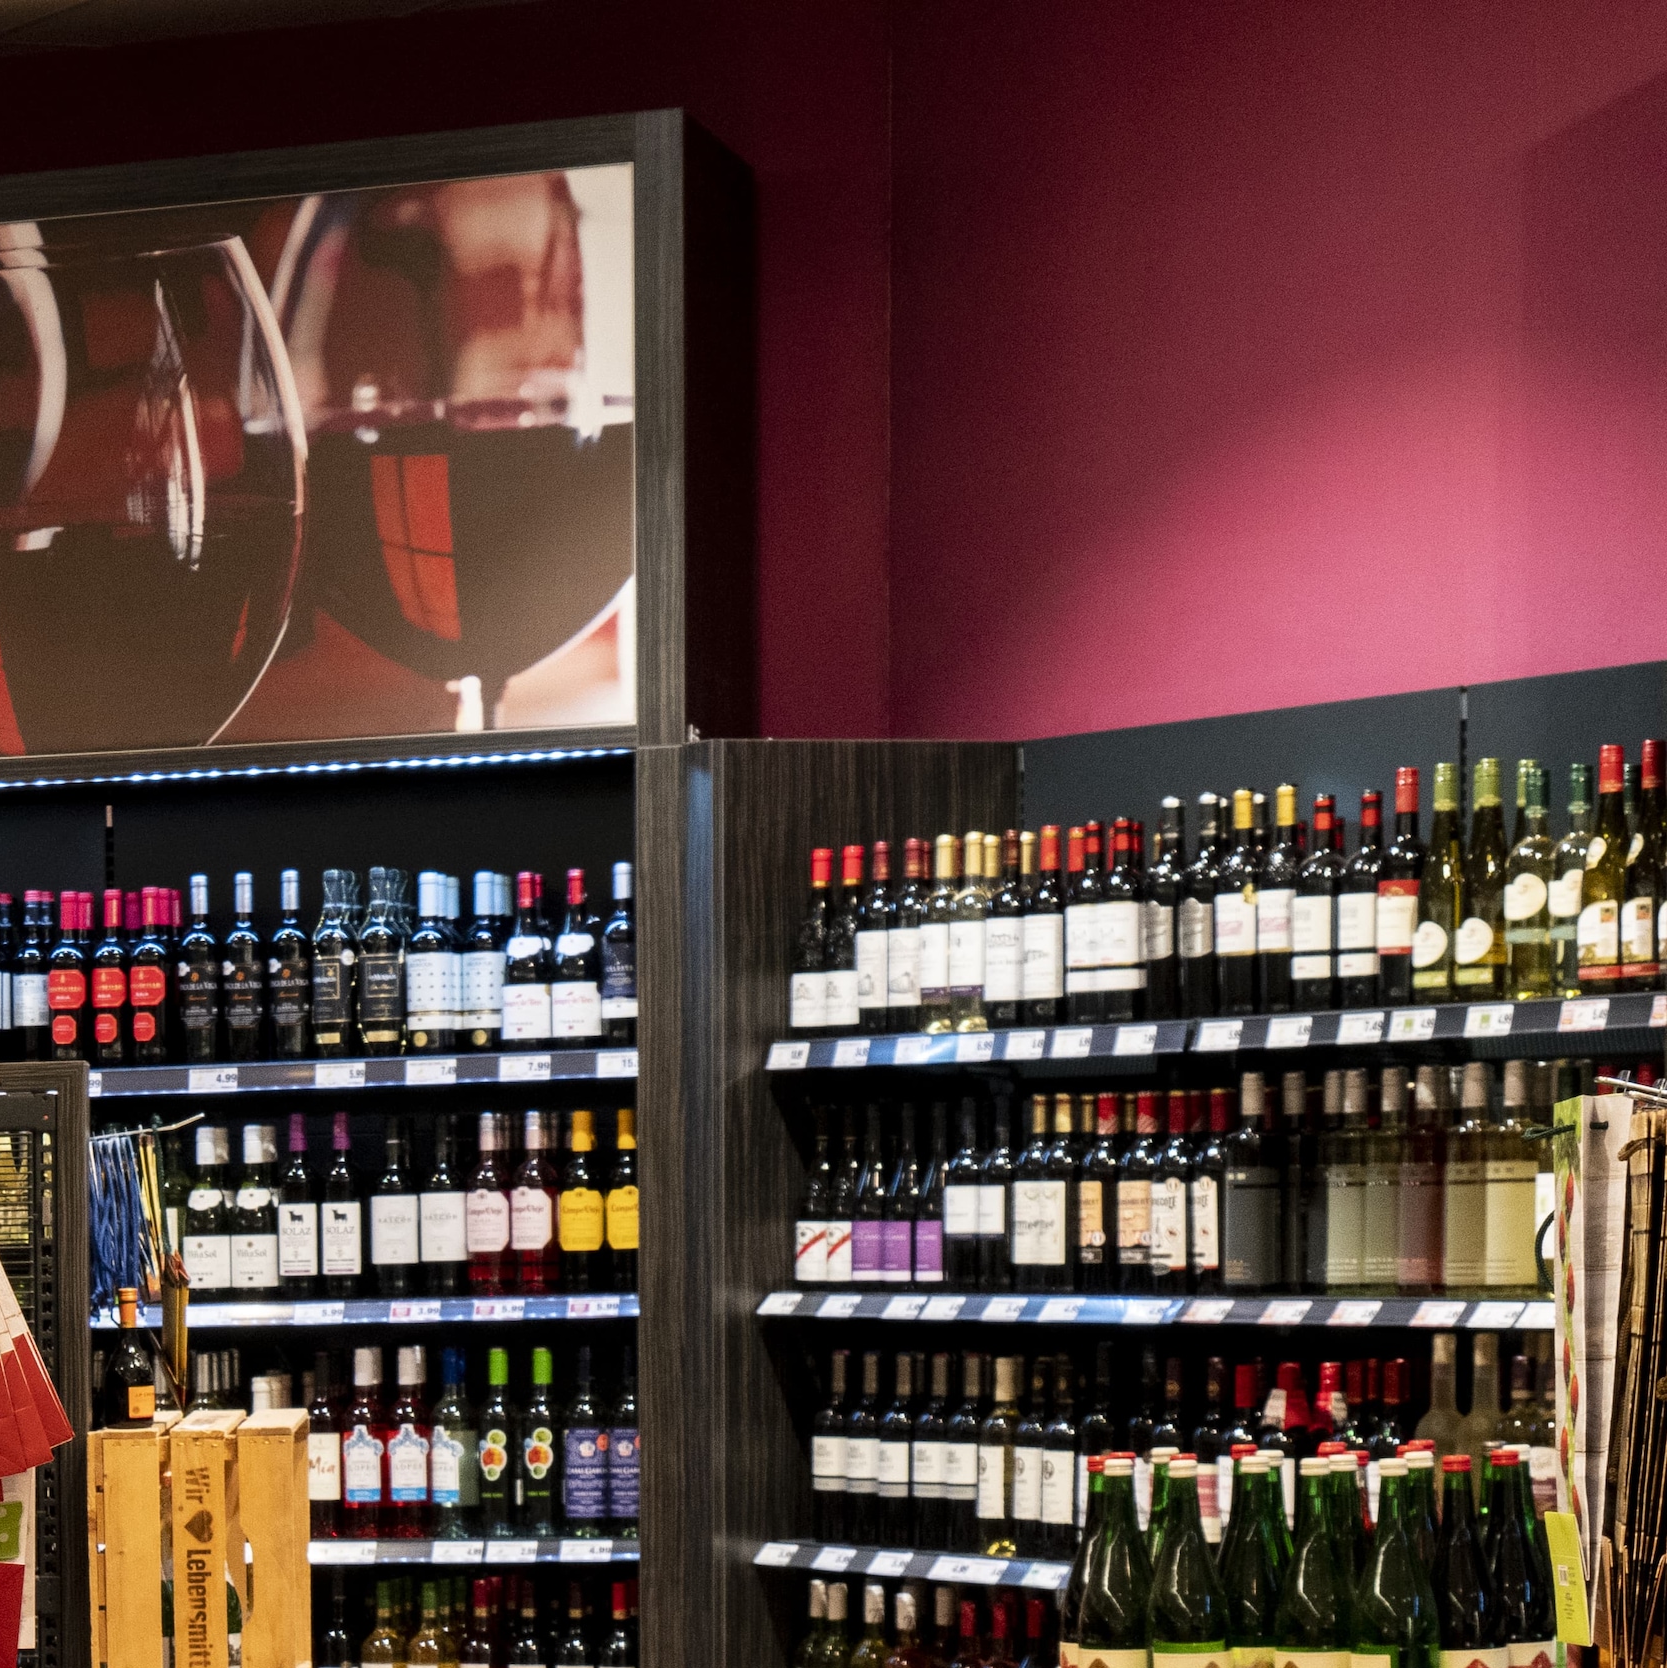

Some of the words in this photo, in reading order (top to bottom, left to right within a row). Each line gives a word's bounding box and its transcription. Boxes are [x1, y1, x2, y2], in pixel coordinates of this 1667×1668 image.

[281, 1227, 312, 1236] SOLAZ
[325, 1225, 355, 1235] SOLAZ
[186, 1466, 208, 1506] Wir
